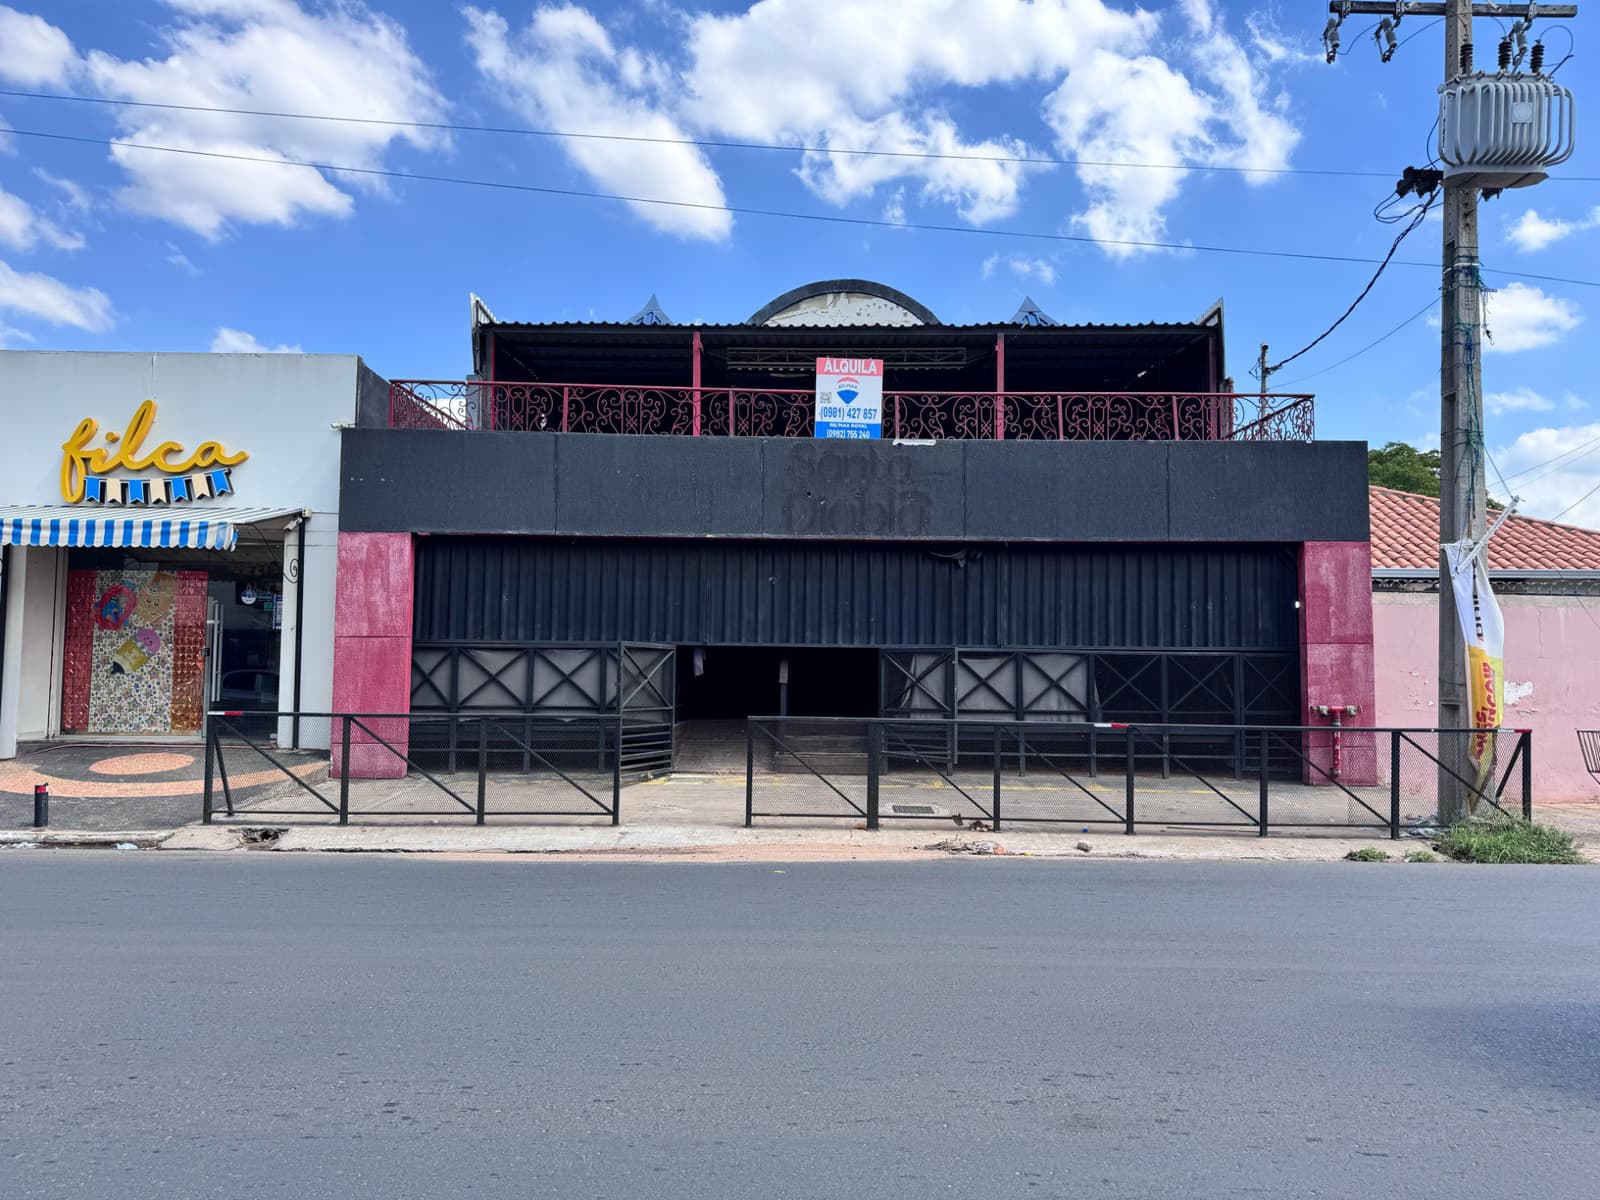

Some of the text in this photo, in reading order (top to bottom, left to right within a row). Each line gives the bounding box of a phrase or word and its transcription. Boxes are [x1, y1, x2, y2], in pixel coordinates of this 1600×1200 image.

[824, 359, 877, 374] ALQUILA
[820, 406, 878, 420] (0981) 427 857
[60, 399, 249, 504] filca
